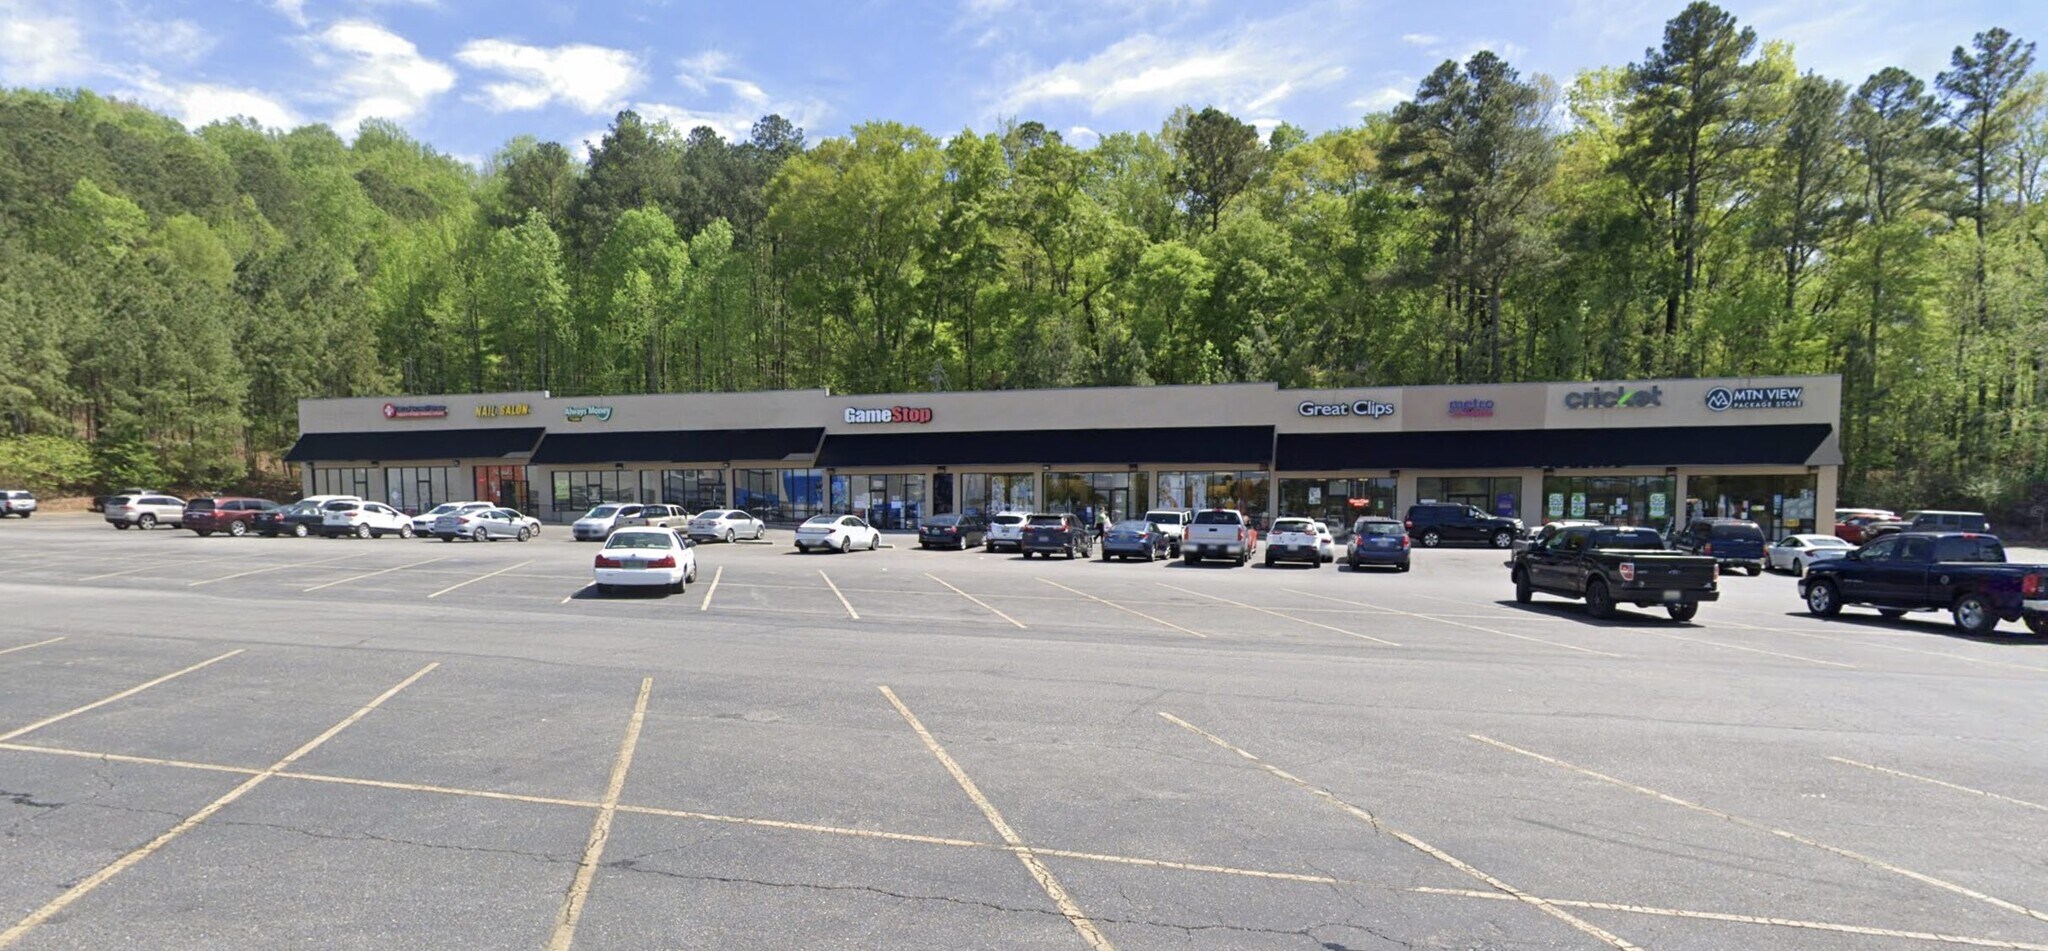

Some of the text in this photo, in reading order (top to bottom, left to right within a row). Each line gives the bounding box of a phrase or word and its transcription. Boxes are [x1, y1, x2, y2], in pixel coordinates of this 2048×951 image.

[1564, 385, 1663, 409] cricket
[1733, 388, 1802, 401] MTN VIEW
[475, 404, 530, 418] NAIL SALON
[1299, 400, 1395, 418] Great Clips
[1449, 399, 1495, 410] metro
[564, 405, 612, 420] Always Money
[844, 406, 932, 423] GameStop
